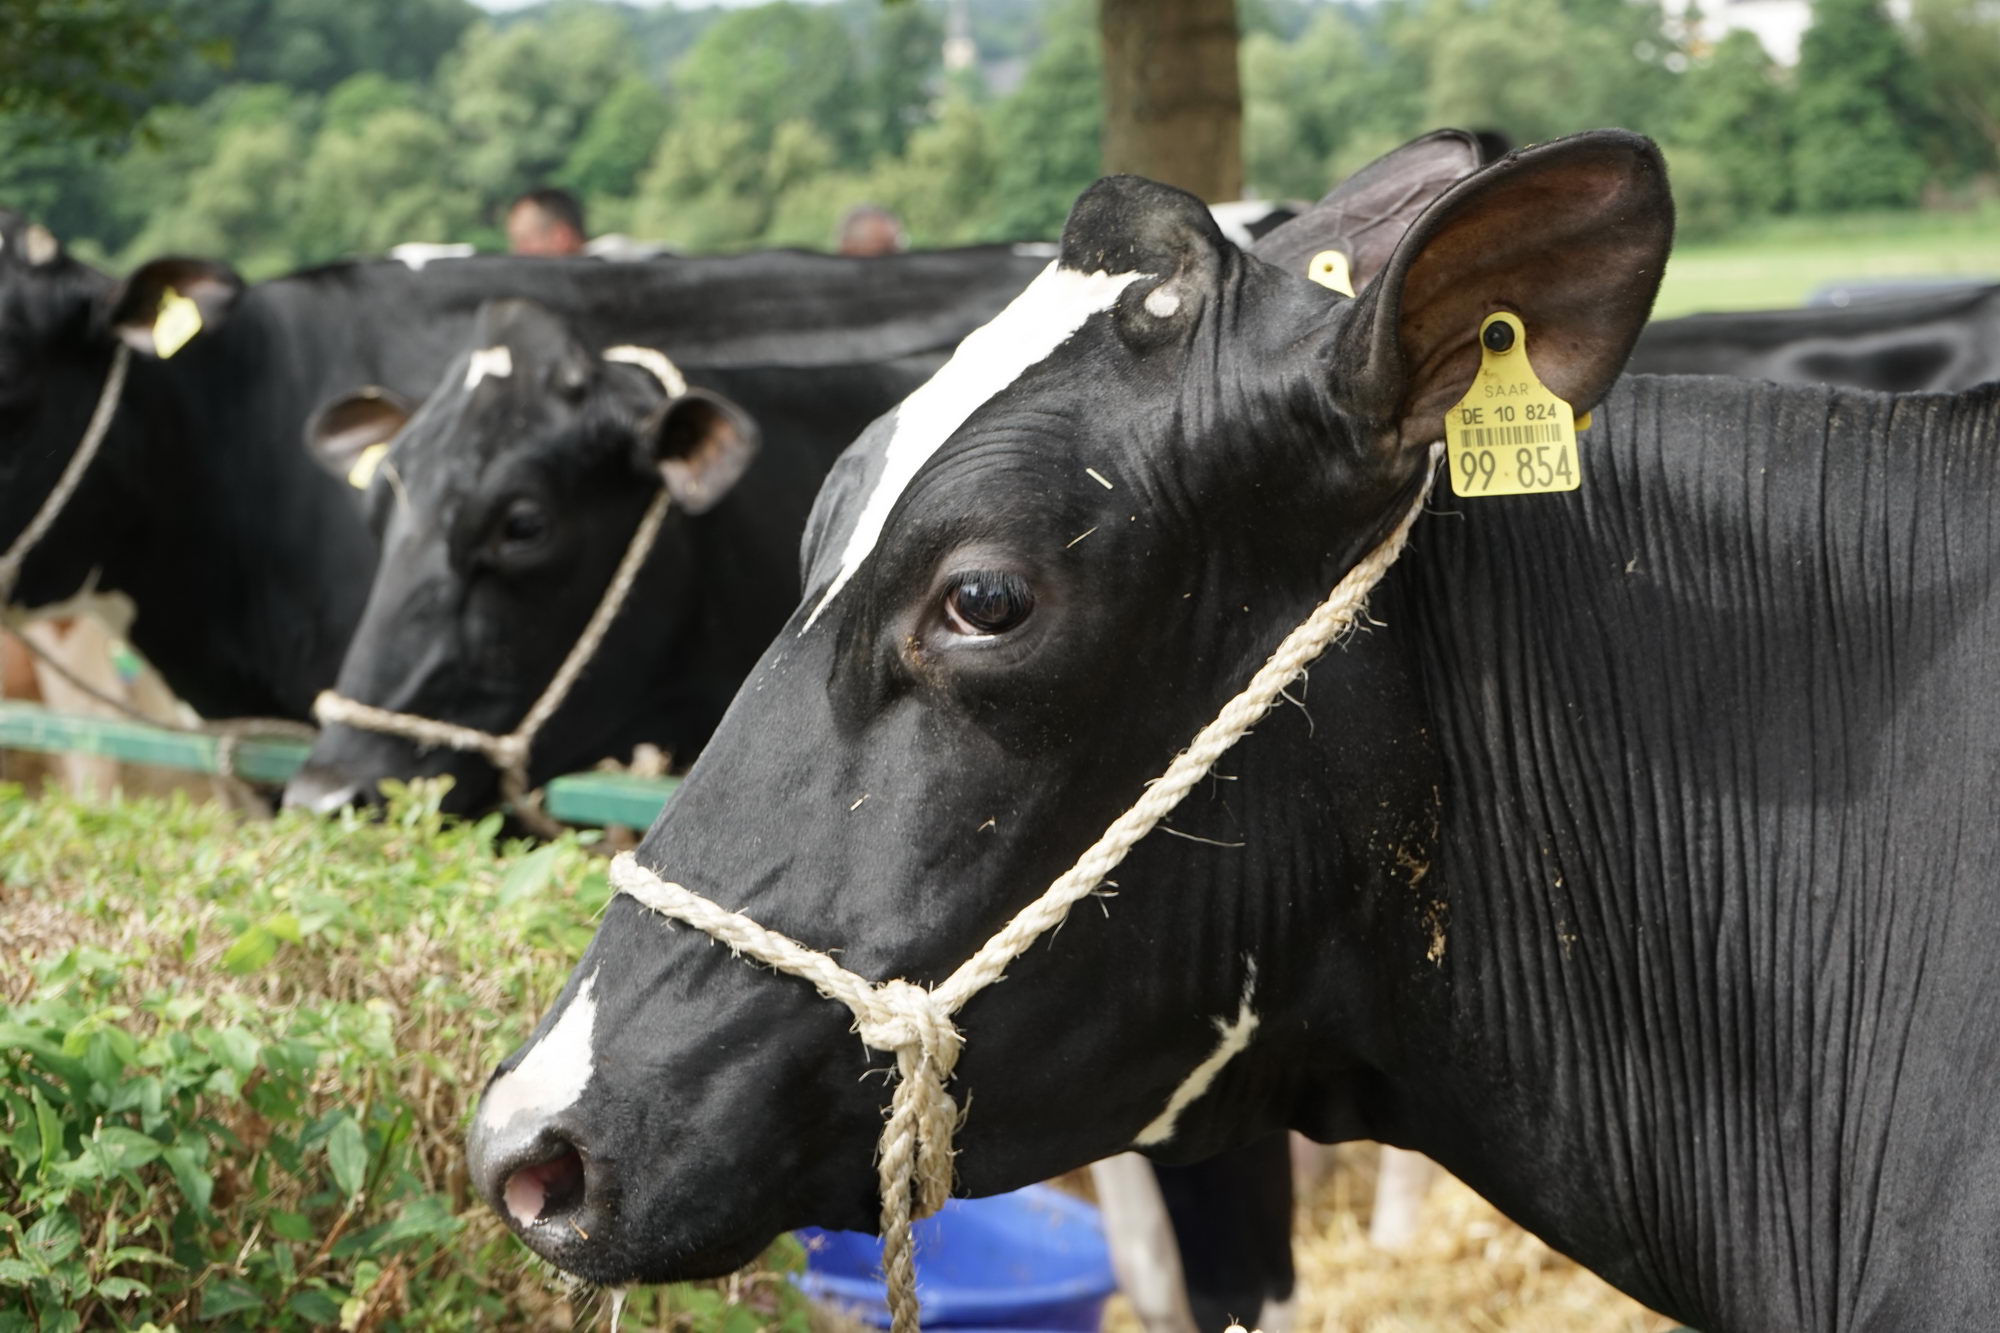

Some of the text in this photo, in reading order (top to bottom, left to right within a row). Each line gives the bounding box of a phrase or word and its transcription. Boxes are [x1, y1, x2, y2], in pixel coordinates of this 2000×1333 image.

[1484, 382, 1529, 398] SAAR
[1462, 403, 1557, 425] DE 10 824
[1460, 445, 1572, 492] 99 854
